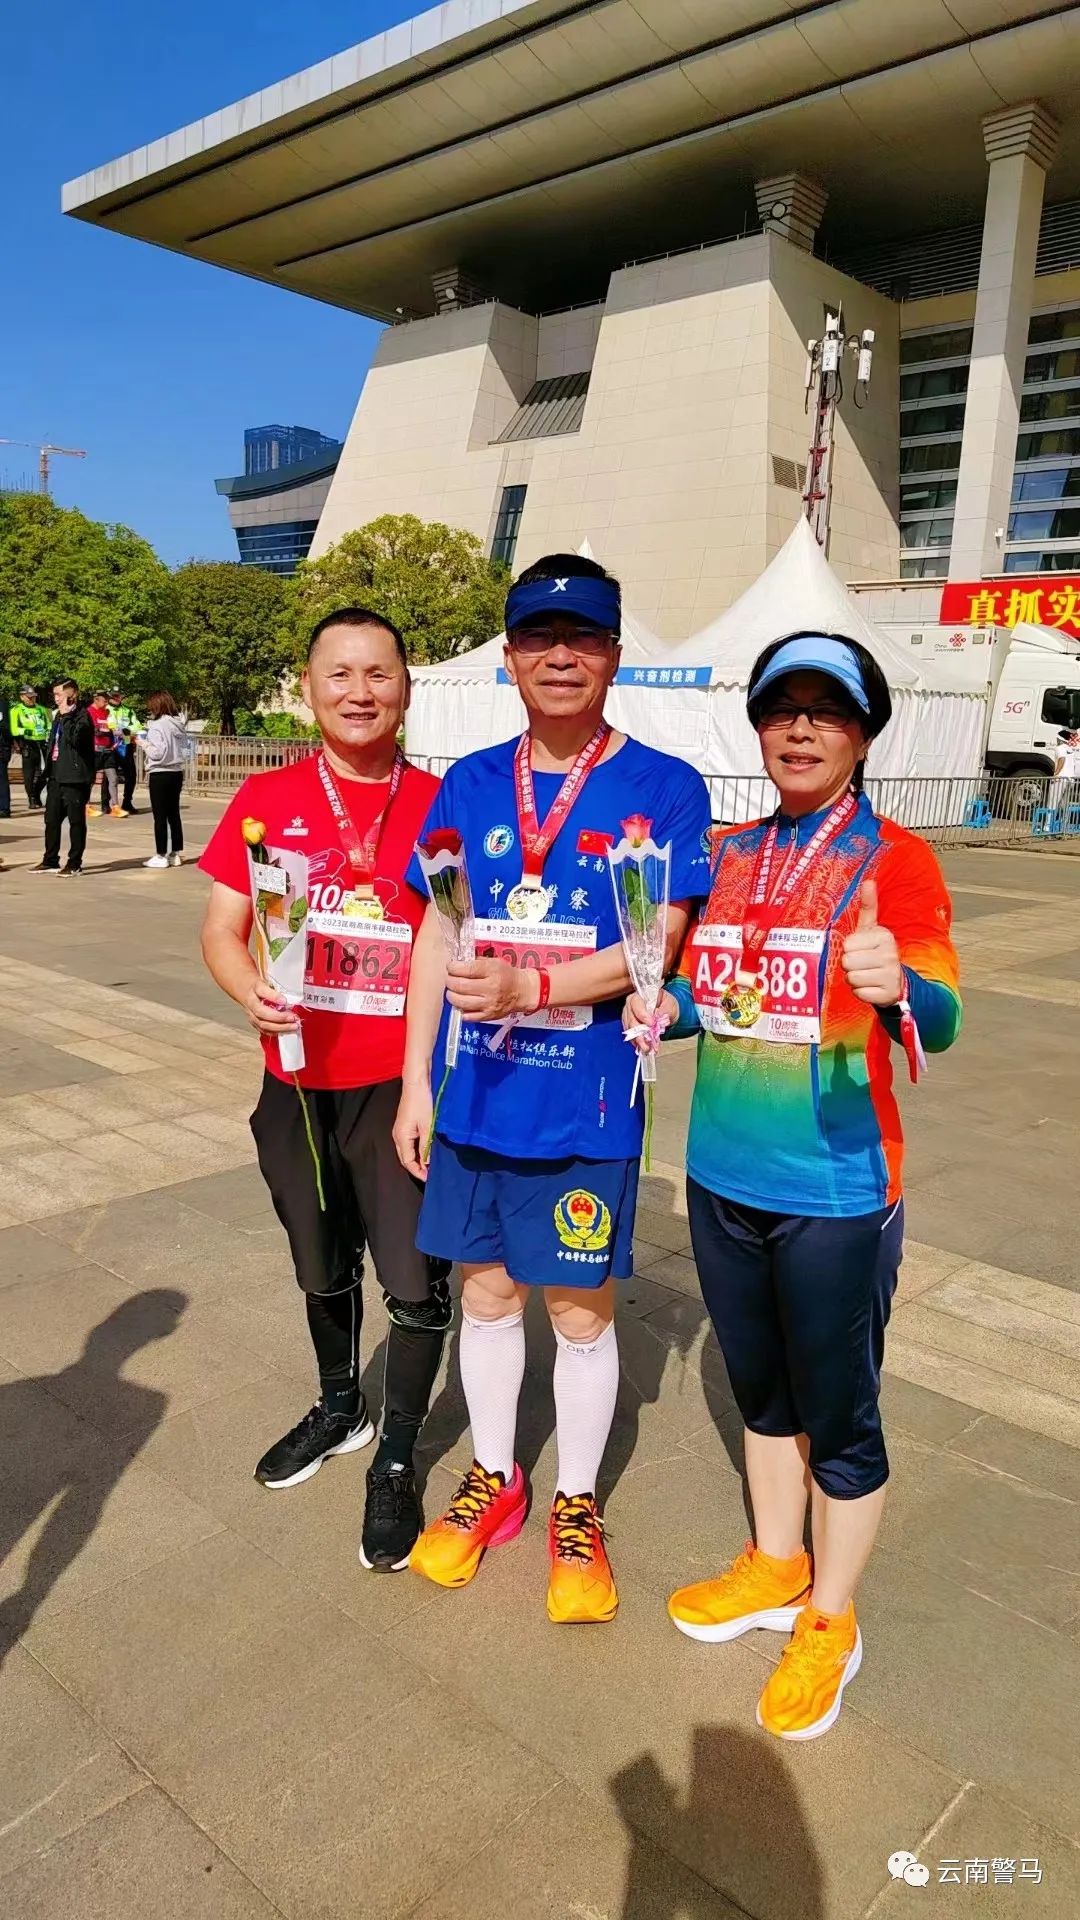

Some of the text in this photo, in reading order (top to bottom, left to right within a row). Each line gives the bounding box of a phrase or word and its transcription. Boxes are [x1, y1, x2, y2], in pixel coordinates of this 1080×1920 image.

[633, 669, 697, 683] 兴奋剂检测
[576, 855, 606, 873] 云南
[489, 878, 590, 911] 中警察
[695, 951, 808, 1000] A2388
[480, 1047, 506, 1061] Police
[507, 1053, 550, 1069] Marathon
[551, 1059, 573, 1071] Club
